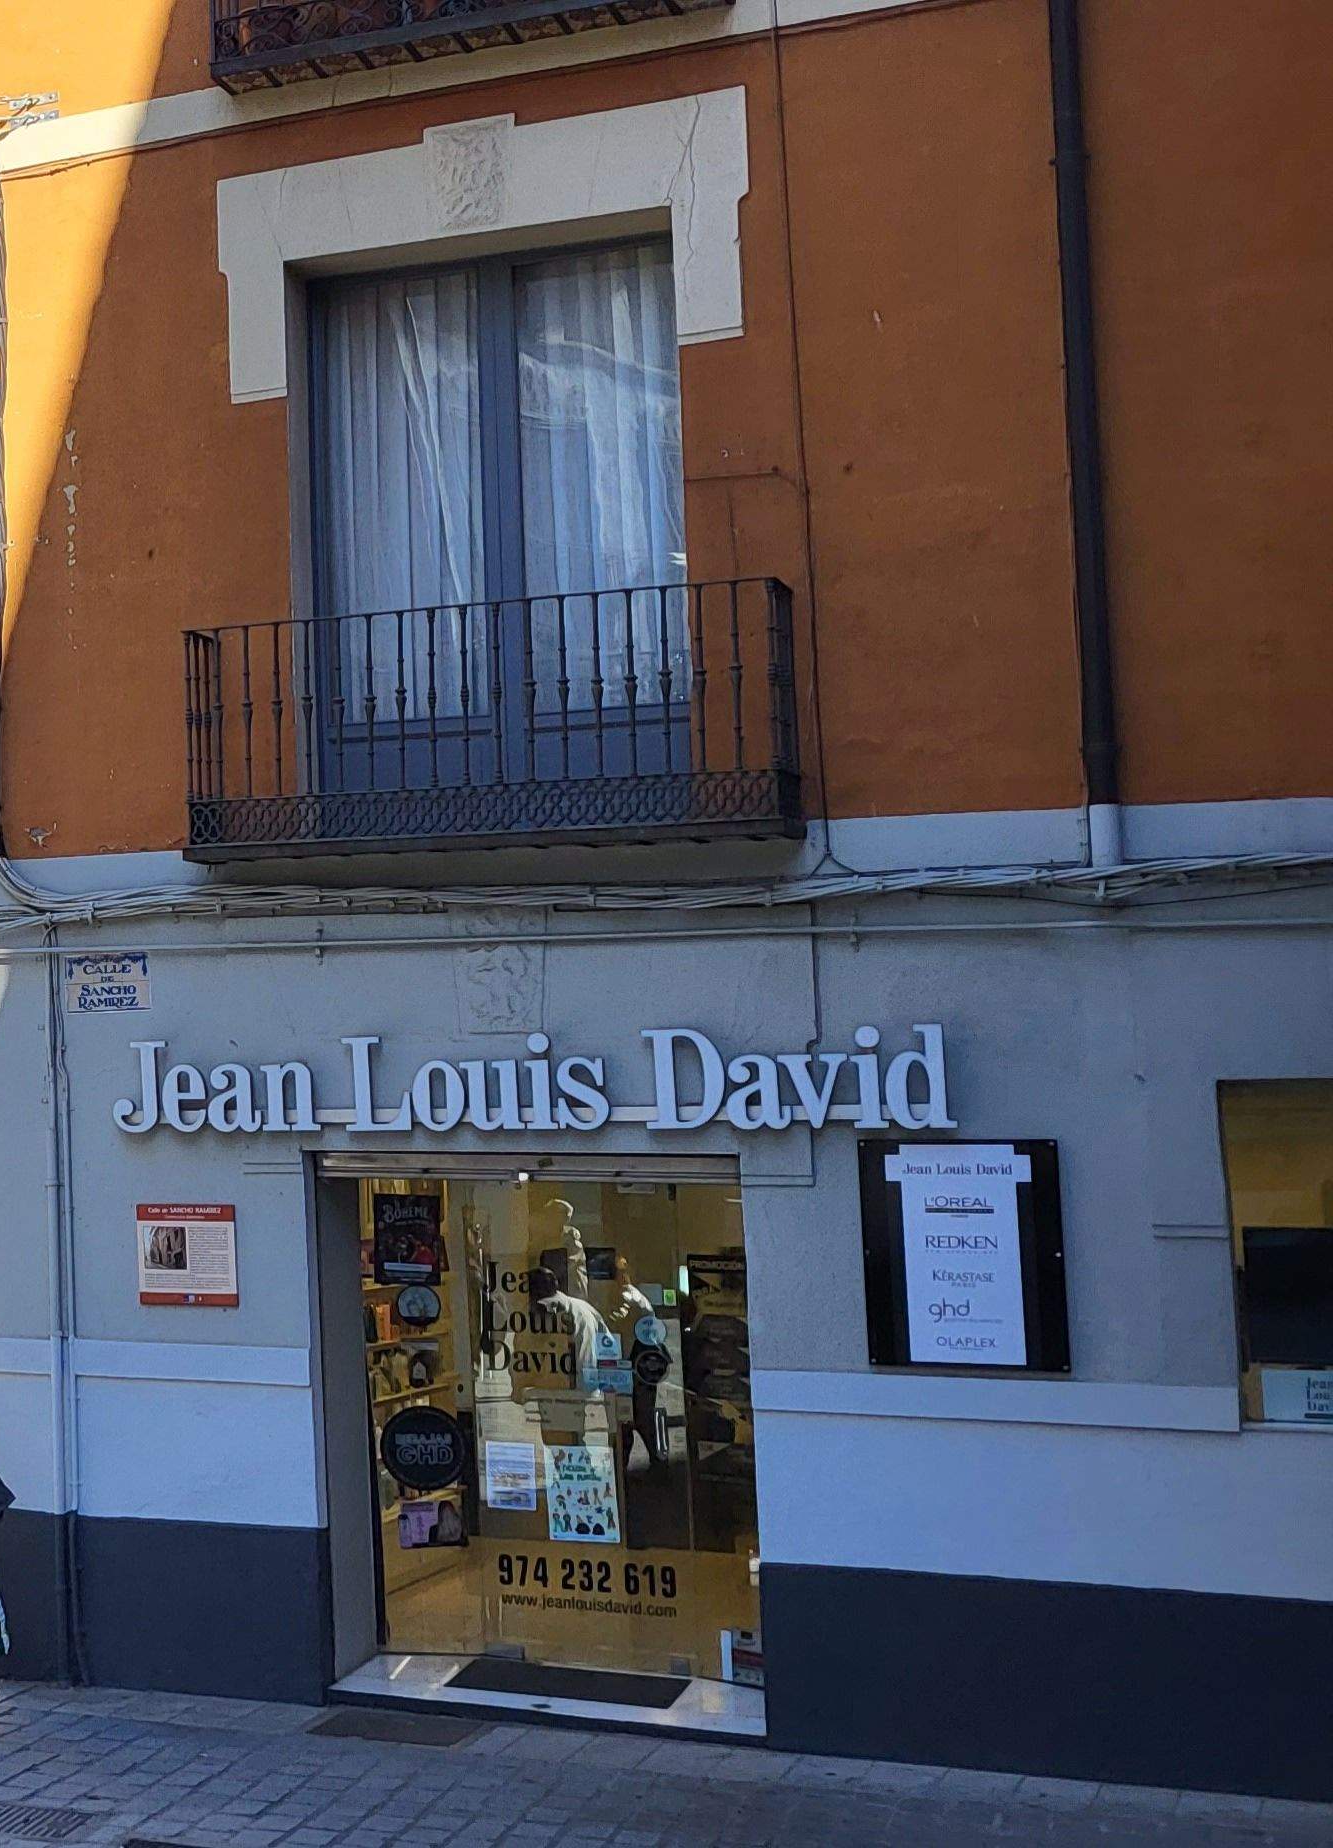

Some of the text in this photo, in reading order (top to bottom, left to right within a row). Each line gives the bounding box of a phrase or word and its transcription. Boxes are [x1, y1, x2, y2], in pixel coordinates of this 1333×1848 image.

[82, 963, 132, 976] CALLE
[100, 975, 114, 983] DE
[80, 984, 137, 996] SANCHO
[113, 1023, 958, 1133] Jean Louis David
[901, 1163, 1013, 1176] Jean Louis David
[925, 1234, 999, 1250] REDKEN
[484, 1300, 576, 1335] Louis
[928, 1297, 970, 1324] ghd
[936, 1335, 996, 1349] OLAPLEX
[486, 1339, 577, 1375] David
[498, 1554, 677, 1599] 974 232 619
[501, 1592, 678, 1619] www.jeanlouisdavid.com
